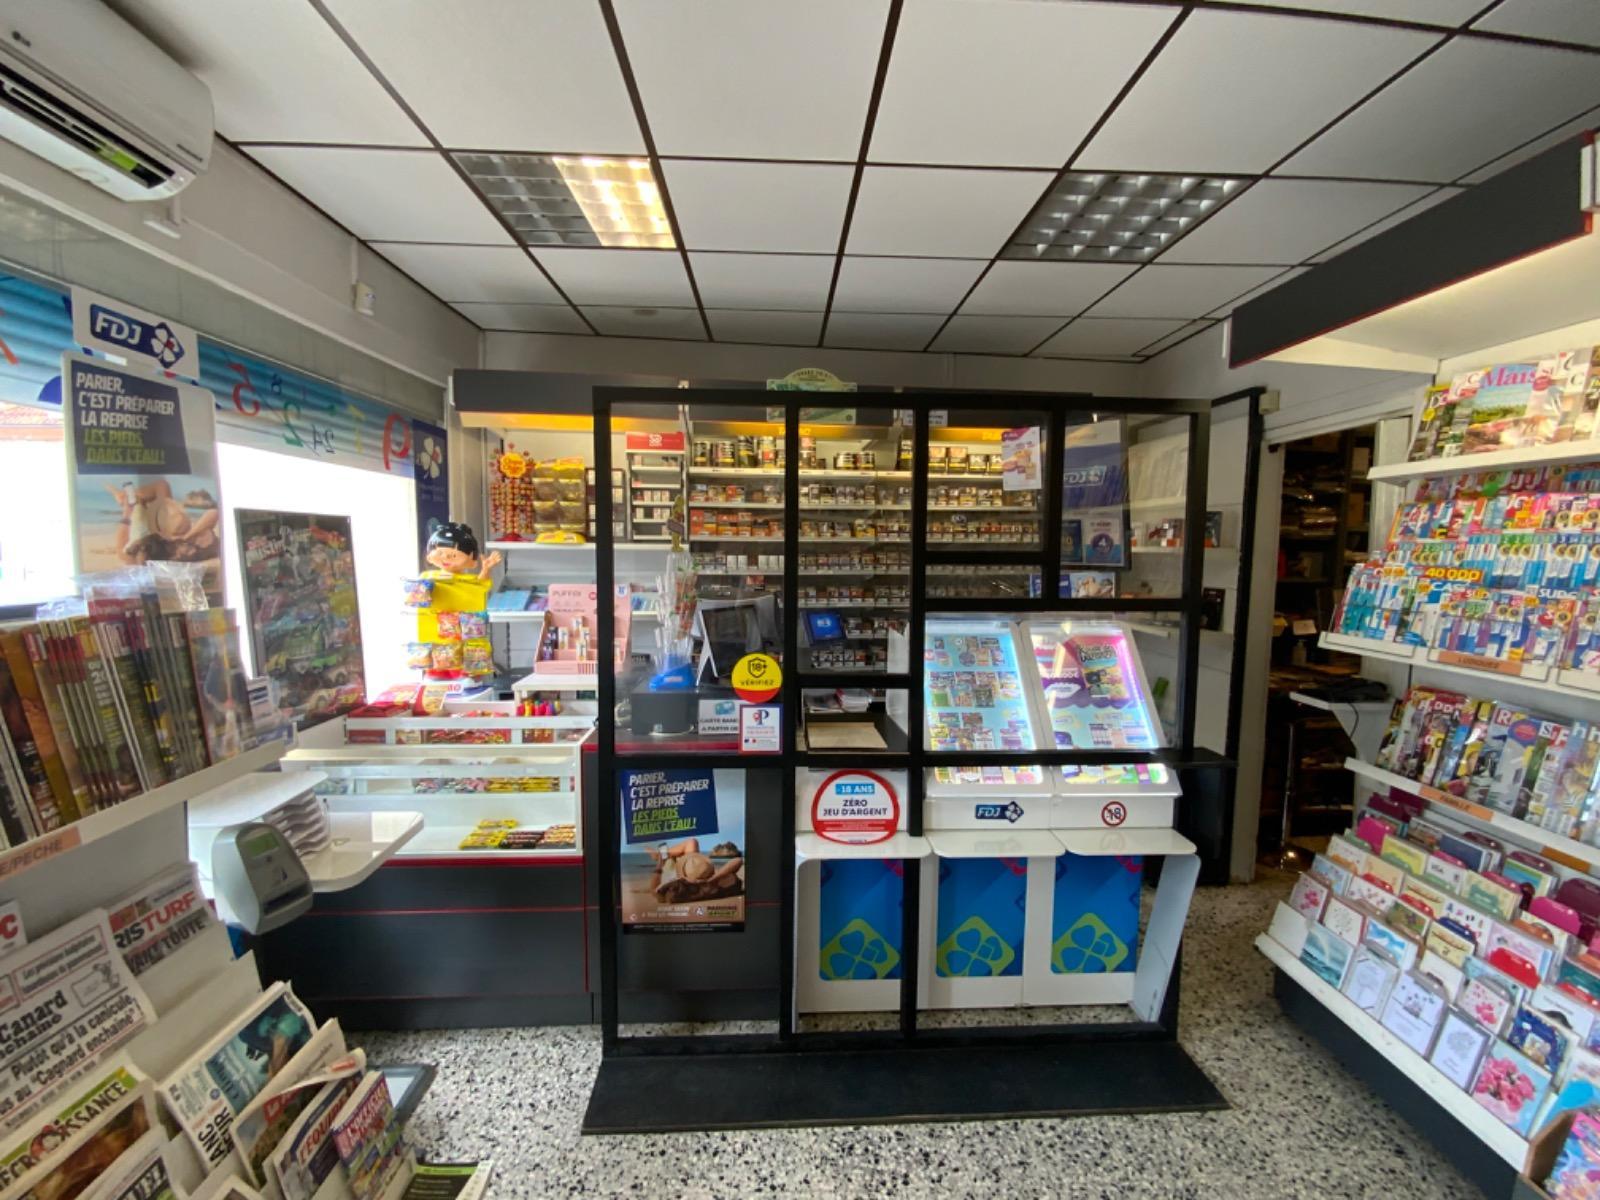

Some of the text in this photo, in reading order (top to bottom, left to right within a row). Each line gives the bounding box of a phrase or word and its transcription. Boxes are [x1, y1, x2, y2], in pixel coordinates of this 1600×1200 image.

[96, 311, 142, 346] FDJ
[76, 372, 126, 394] PARIER,
[78, 390, 113, 410] C'EST
[80, 410, 149, 430] LA REPRISE
[83, 428, 144, 447] LES PIEDS
[86, 446, 122, 464] DANS
[629, 770, 667, 787] PARIER,
[630, 784, 657, 799] C'EST
[853, 785, 874, 793] ANS
[631, 793, 686, 811] LA REPRISE
[842, 797, 868, 807] ZÉRO
[632, 806, 679, 824] LES PIEDS
[823, 807, 888, 817] JEU D'ARGENT
[977, 806, 1001, 818] FDJ
[633, 821, 662, 836] DANS
